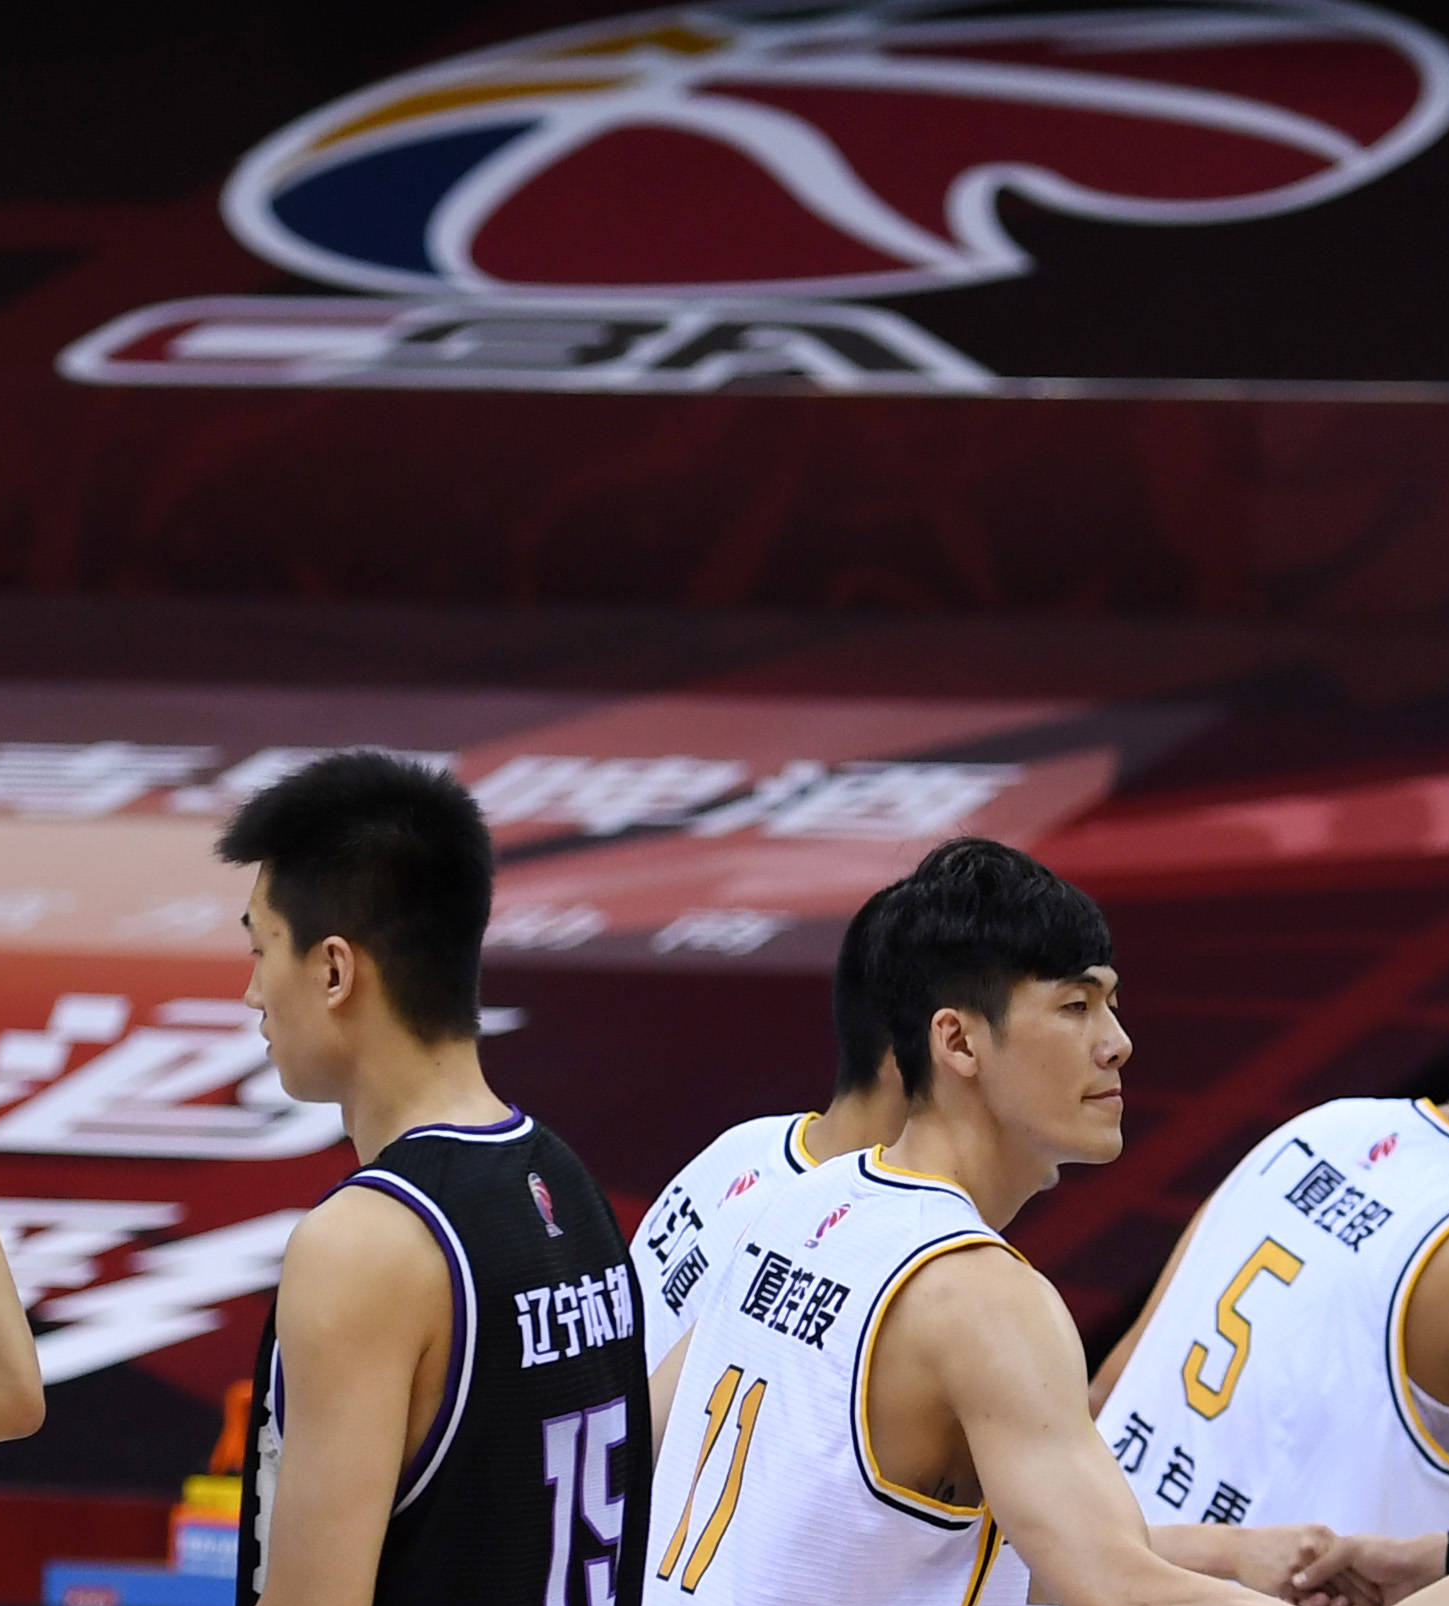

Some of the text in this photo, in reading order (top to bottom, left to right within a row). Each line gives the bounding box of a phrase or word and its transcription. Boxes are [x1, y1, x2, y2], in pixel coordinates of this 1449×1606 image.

[514, 1263, 634, 1369] 辽宁本钢
[1181, 1236, 1305, 1421] 5
[657, 1364, 767, 1594] 11
